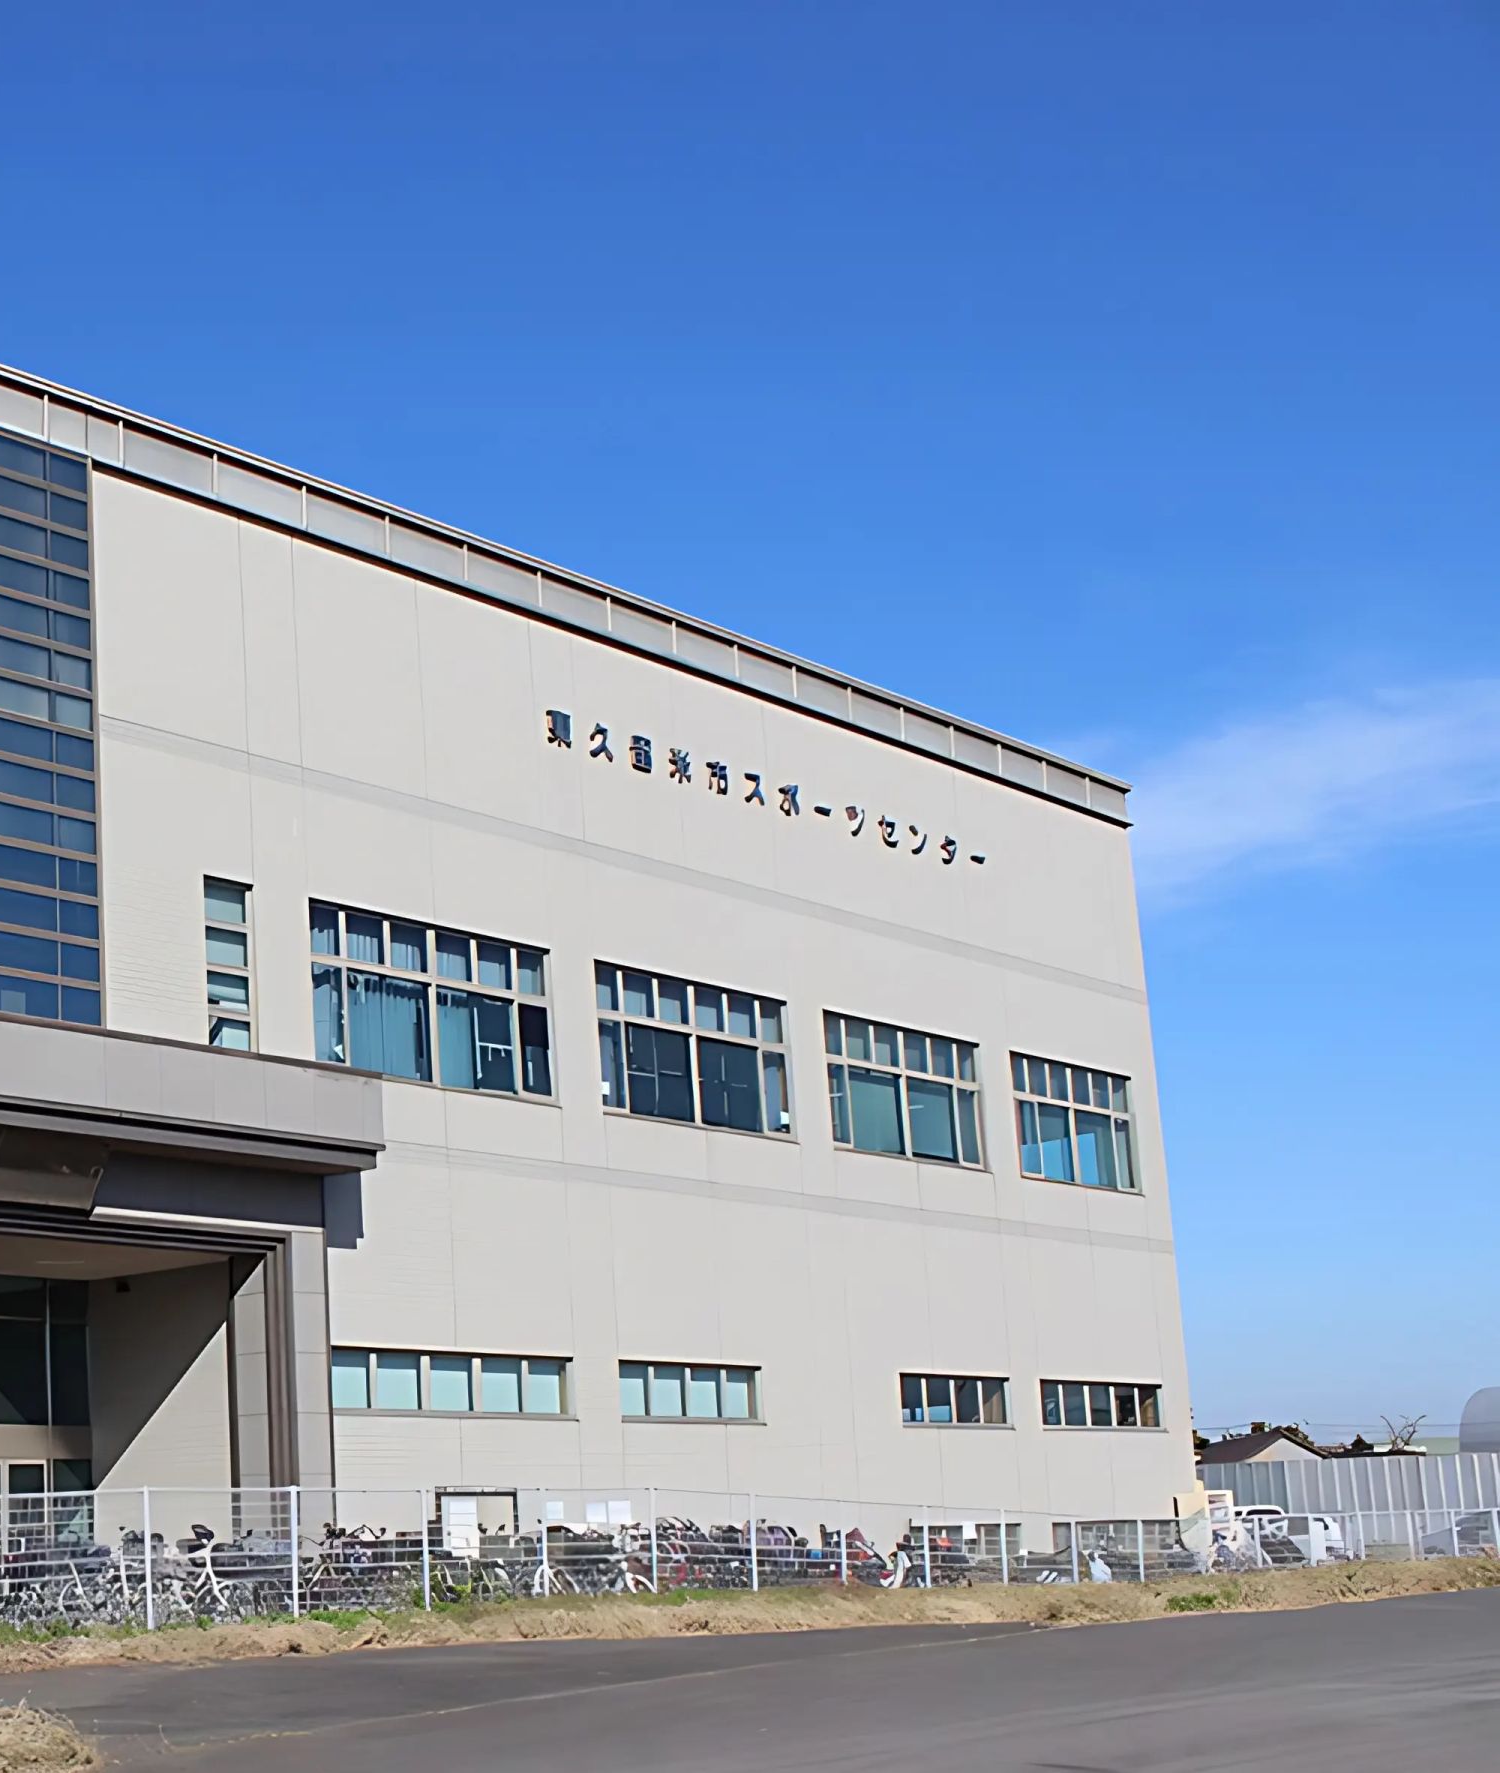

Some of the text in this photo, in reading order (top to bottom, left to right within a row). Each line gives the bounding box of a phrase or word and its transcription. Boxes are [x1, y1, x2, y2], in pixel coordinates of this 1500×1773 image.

[545, 709, 986, 865] 東久留米市スポーツセンター
